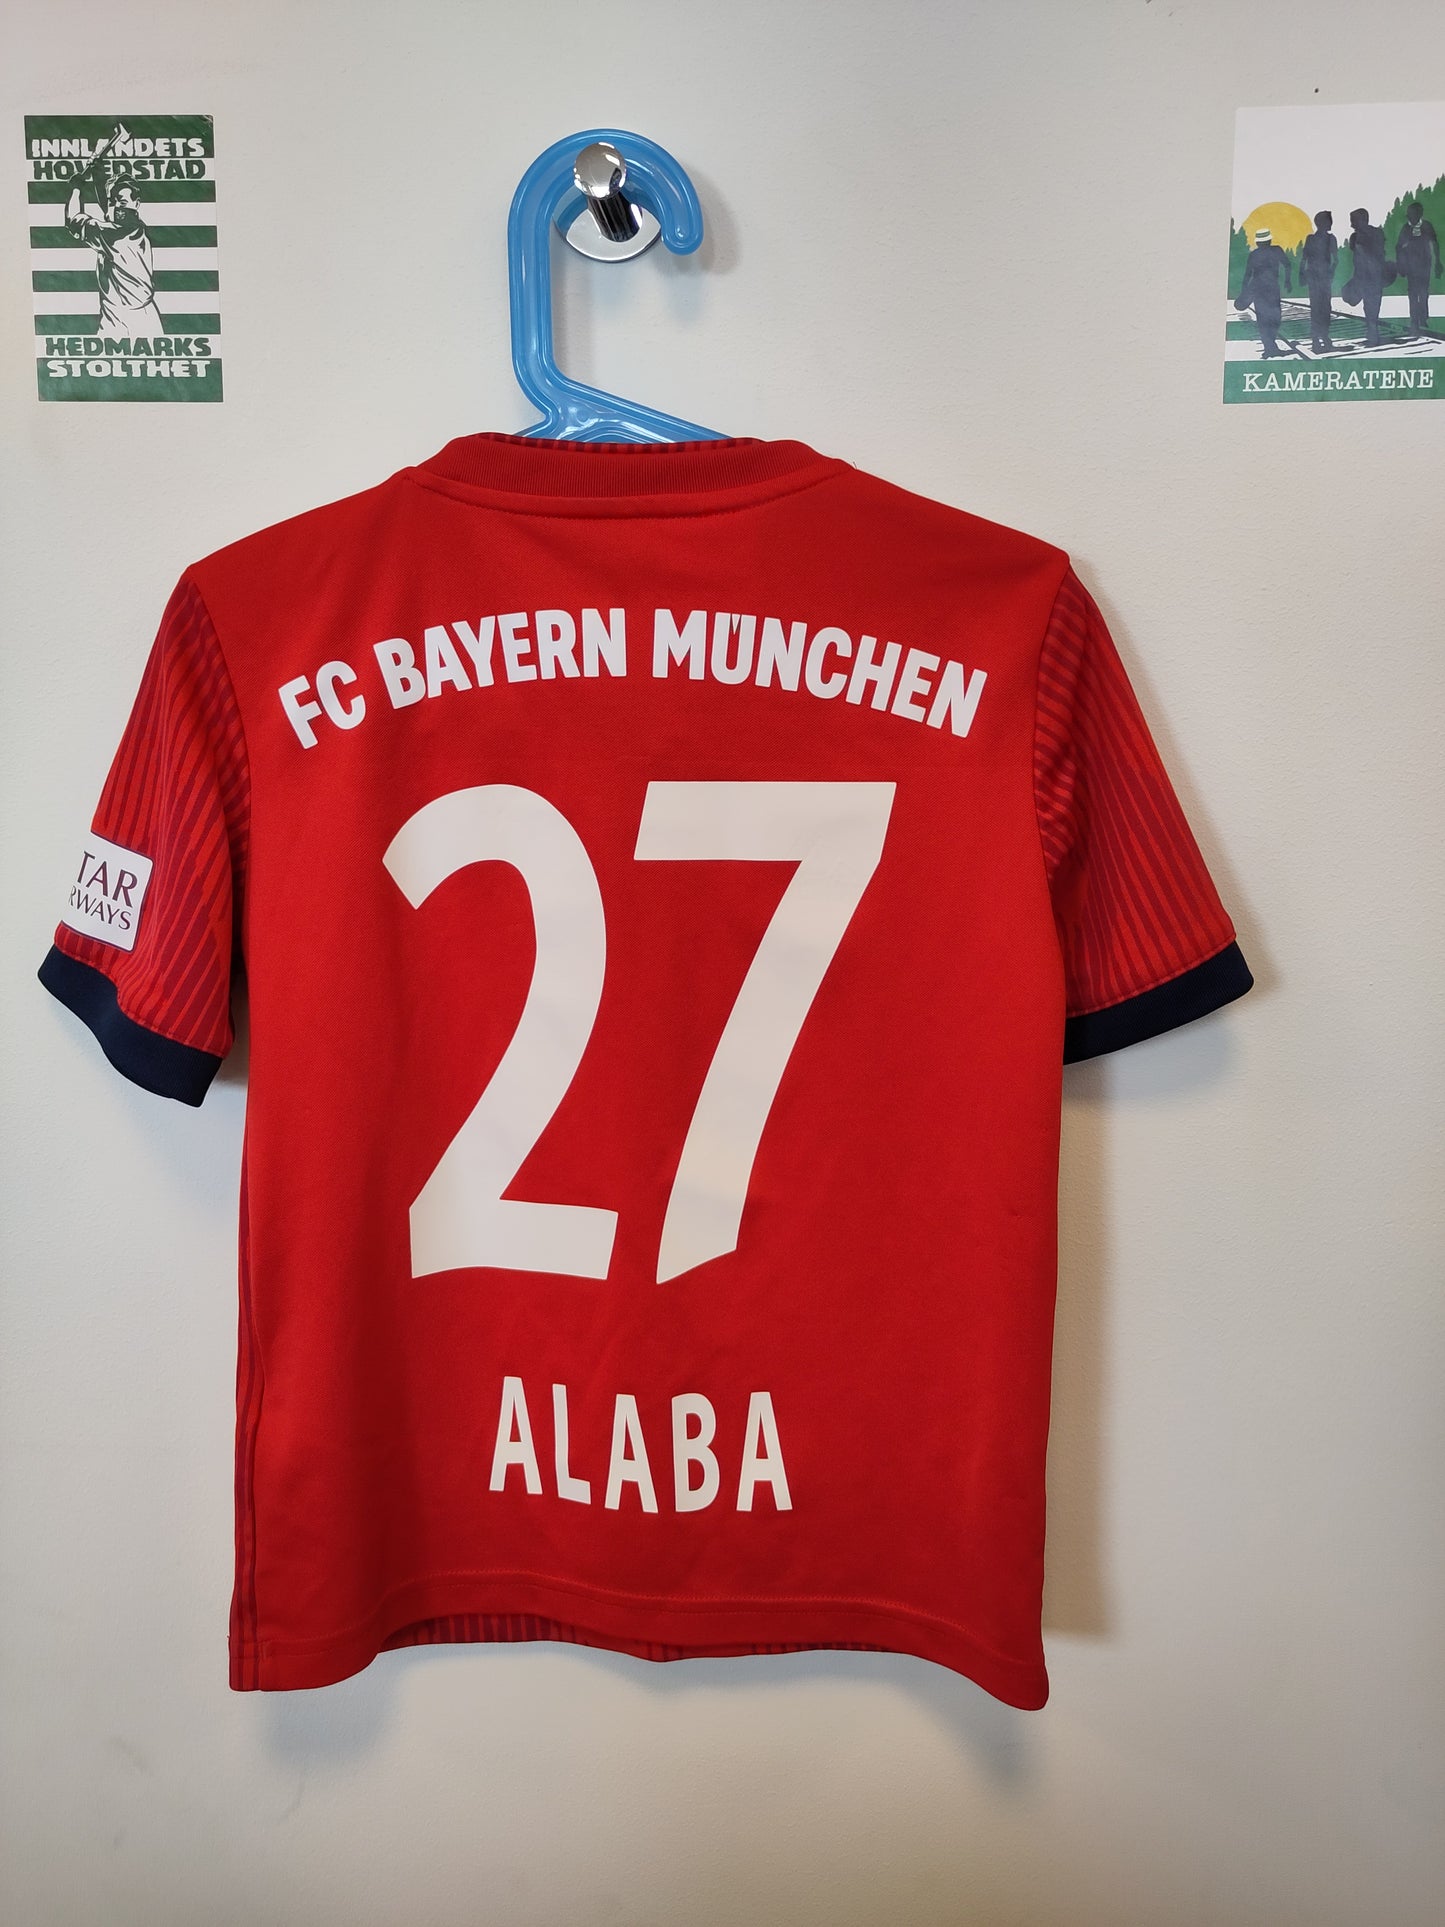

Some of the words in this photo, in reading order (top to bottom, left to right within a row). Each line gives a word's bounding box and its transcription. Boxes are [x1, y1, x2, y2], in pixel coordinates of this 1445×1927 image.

[45, 337, 212, 357] HEDMARKS
[47, 359, 211, 378] STOLTHET
[1242, 369, 1434, 392] KAMERATENE
[278, 660, 366, 750] FC
[373, 608, 627, 709] BAYERN
[652, 608, 988, 738] MÜNCHEN
[77, 850, 138, 908] TAR
[382, 780, 897, 1284] 27
[489, 1376, 793, 1514] ALABA
